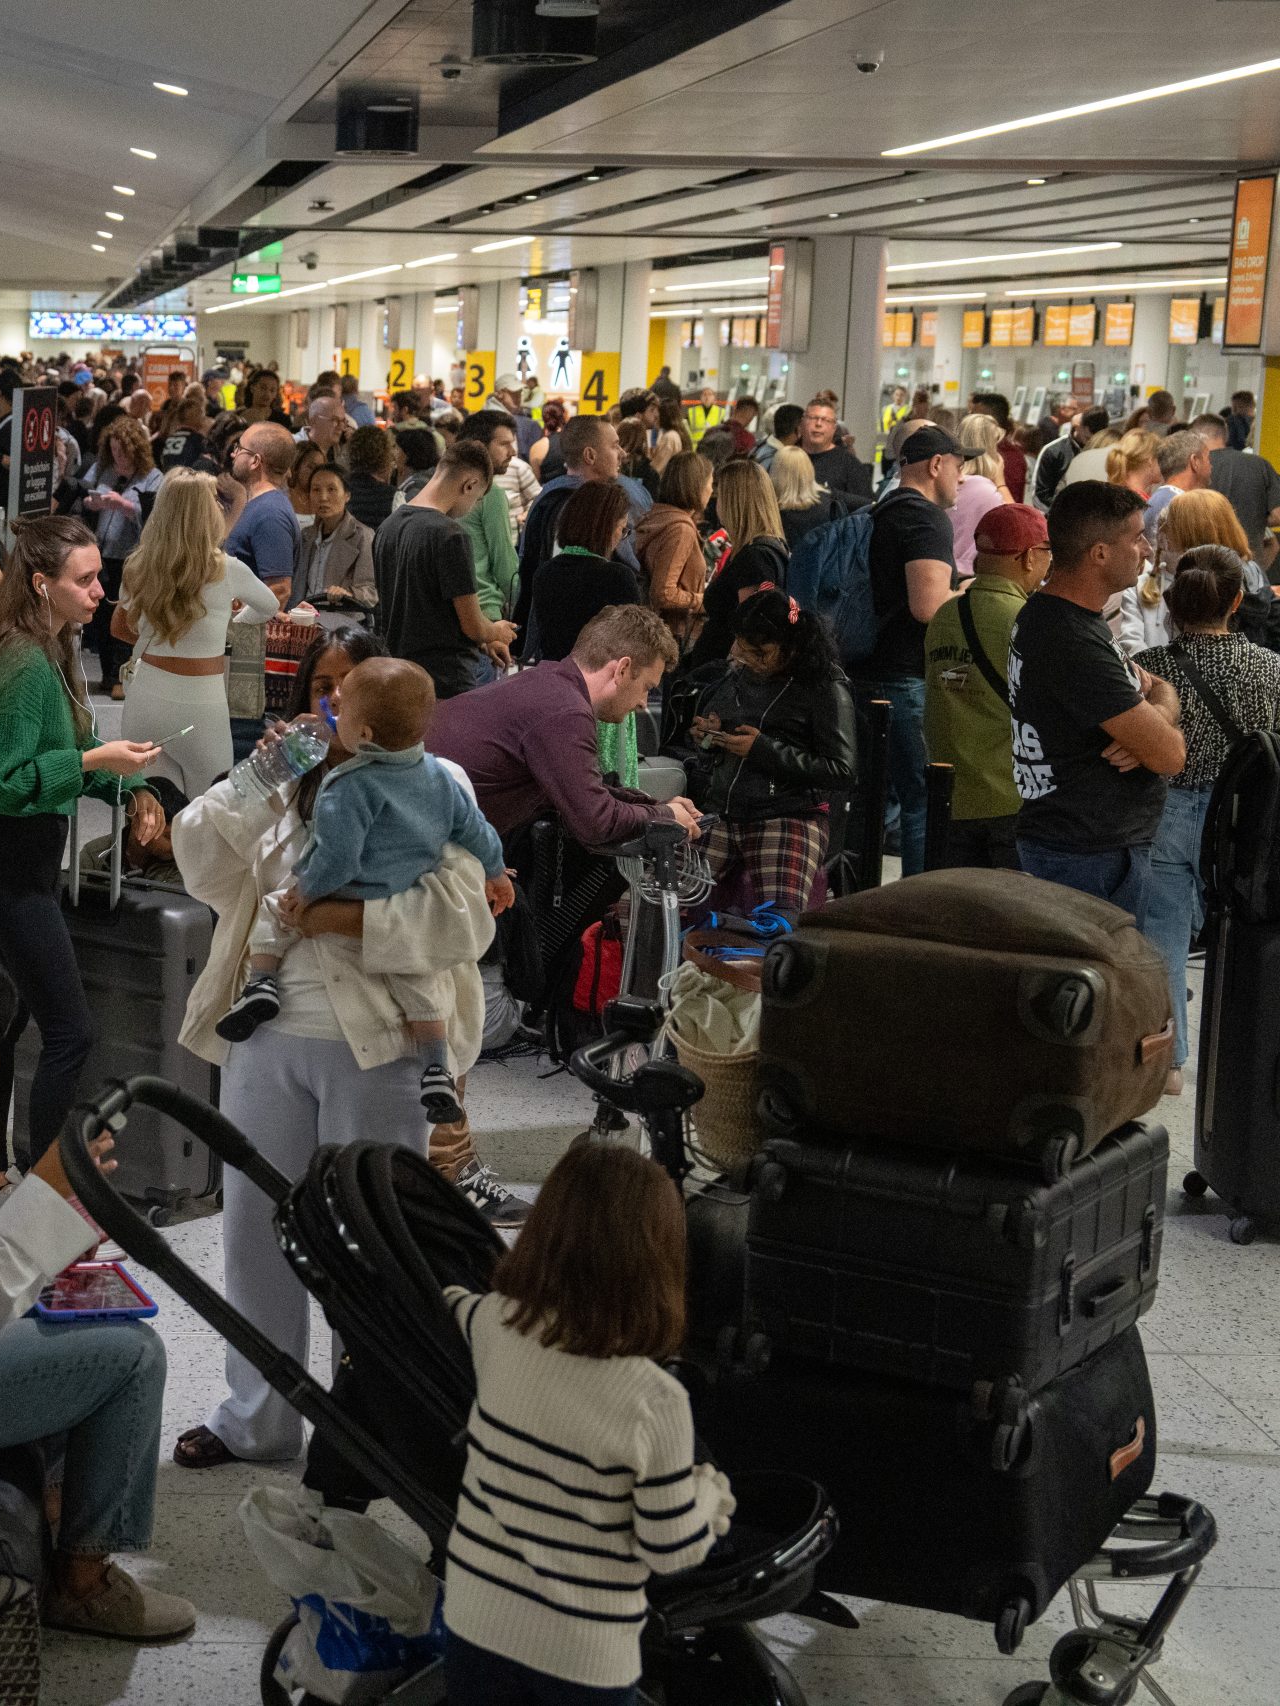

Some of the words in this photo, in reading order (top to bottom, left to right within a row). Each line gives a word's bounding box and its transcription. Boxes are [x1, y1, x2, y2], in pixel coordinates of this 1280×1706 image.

[1234, 256, 1247, 268] BAG
[1247, 255, 1265, 268] DROP
[343, 357, 350, 377] 1
[392, 359, 406, 387] 2
[468, 364, 485, 398] 3
[583, 369, 609, 412] 4
[929, 645, 959, 662] TOMMY
